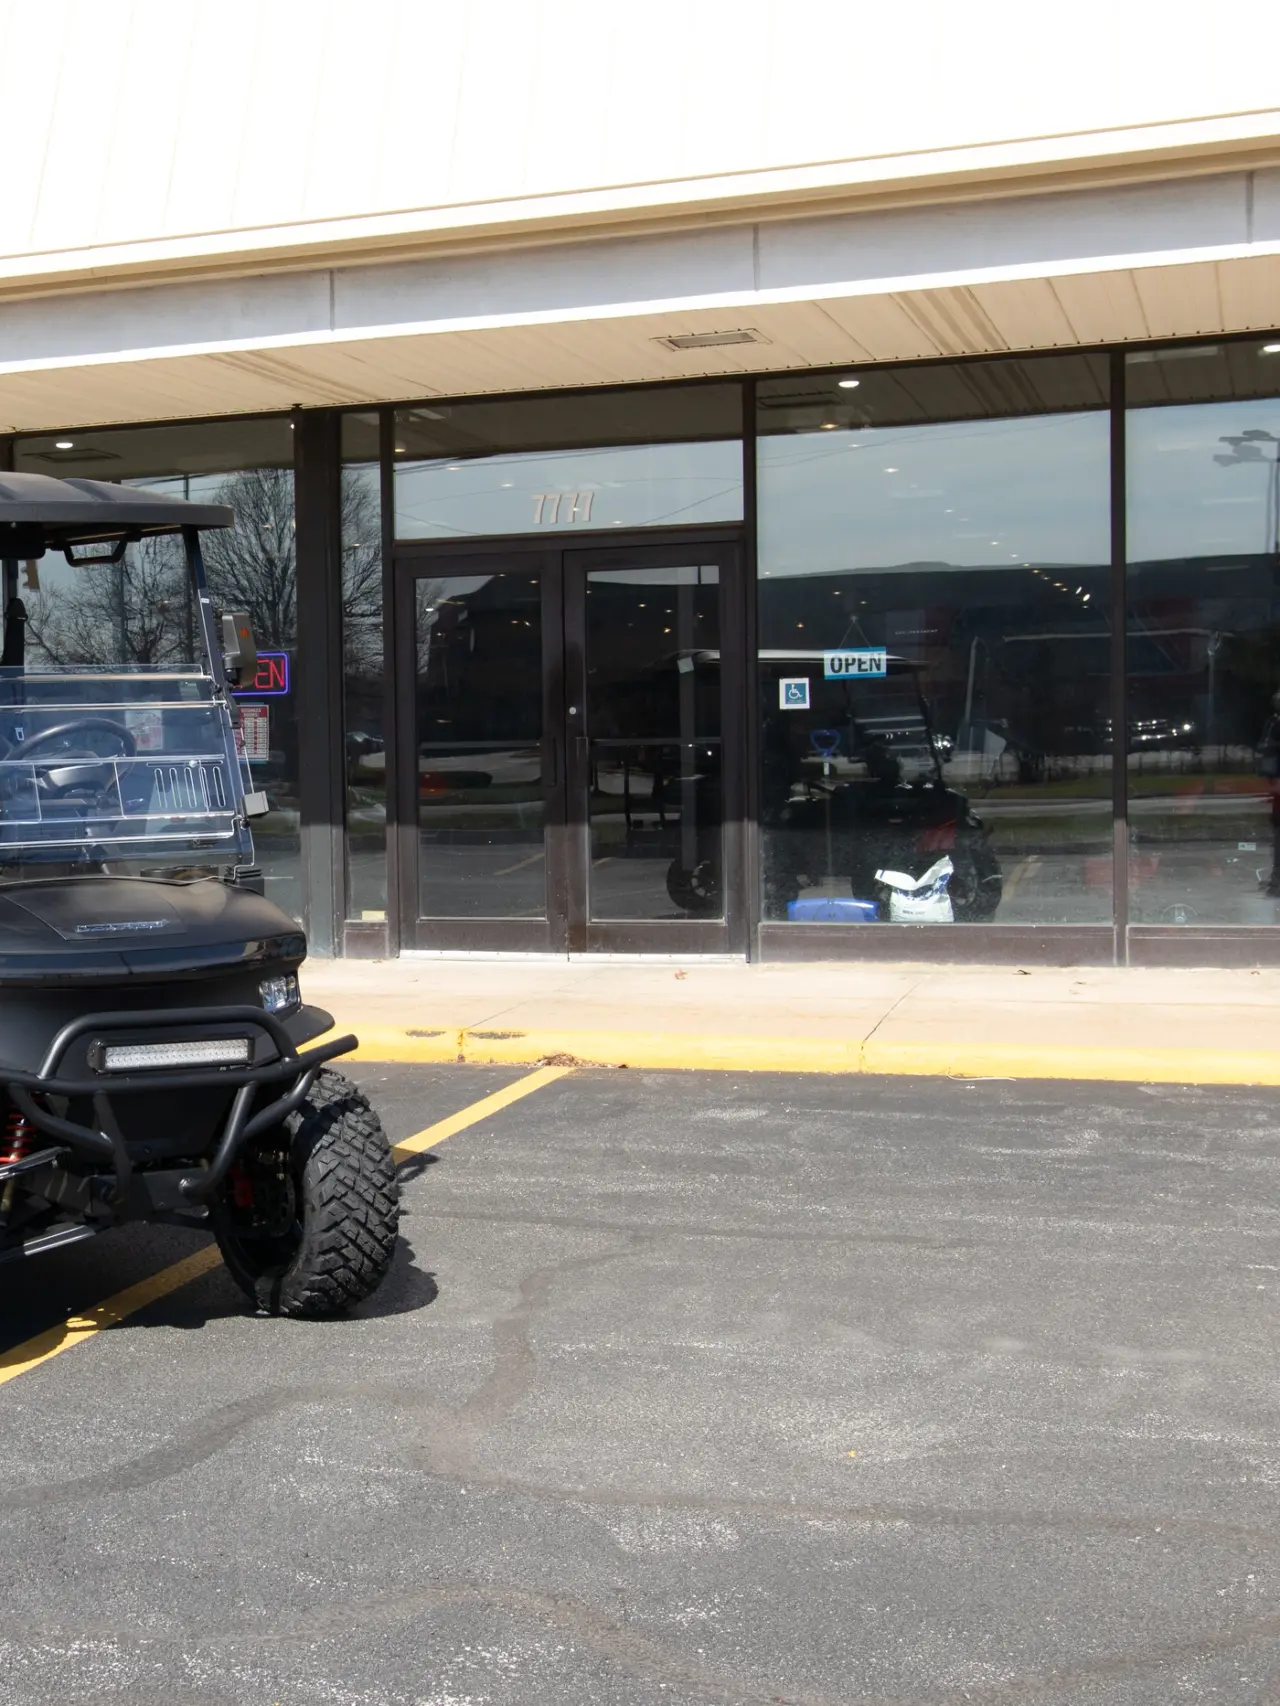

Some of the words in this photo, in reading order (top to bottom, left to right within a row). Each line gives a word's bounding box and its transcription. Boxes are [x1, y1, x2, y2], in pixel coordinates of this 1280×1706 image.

[531, 491, 595, 524] 7777
[254, 658, 285, 689] EN
[830, 653, 882, 674] OPEN
